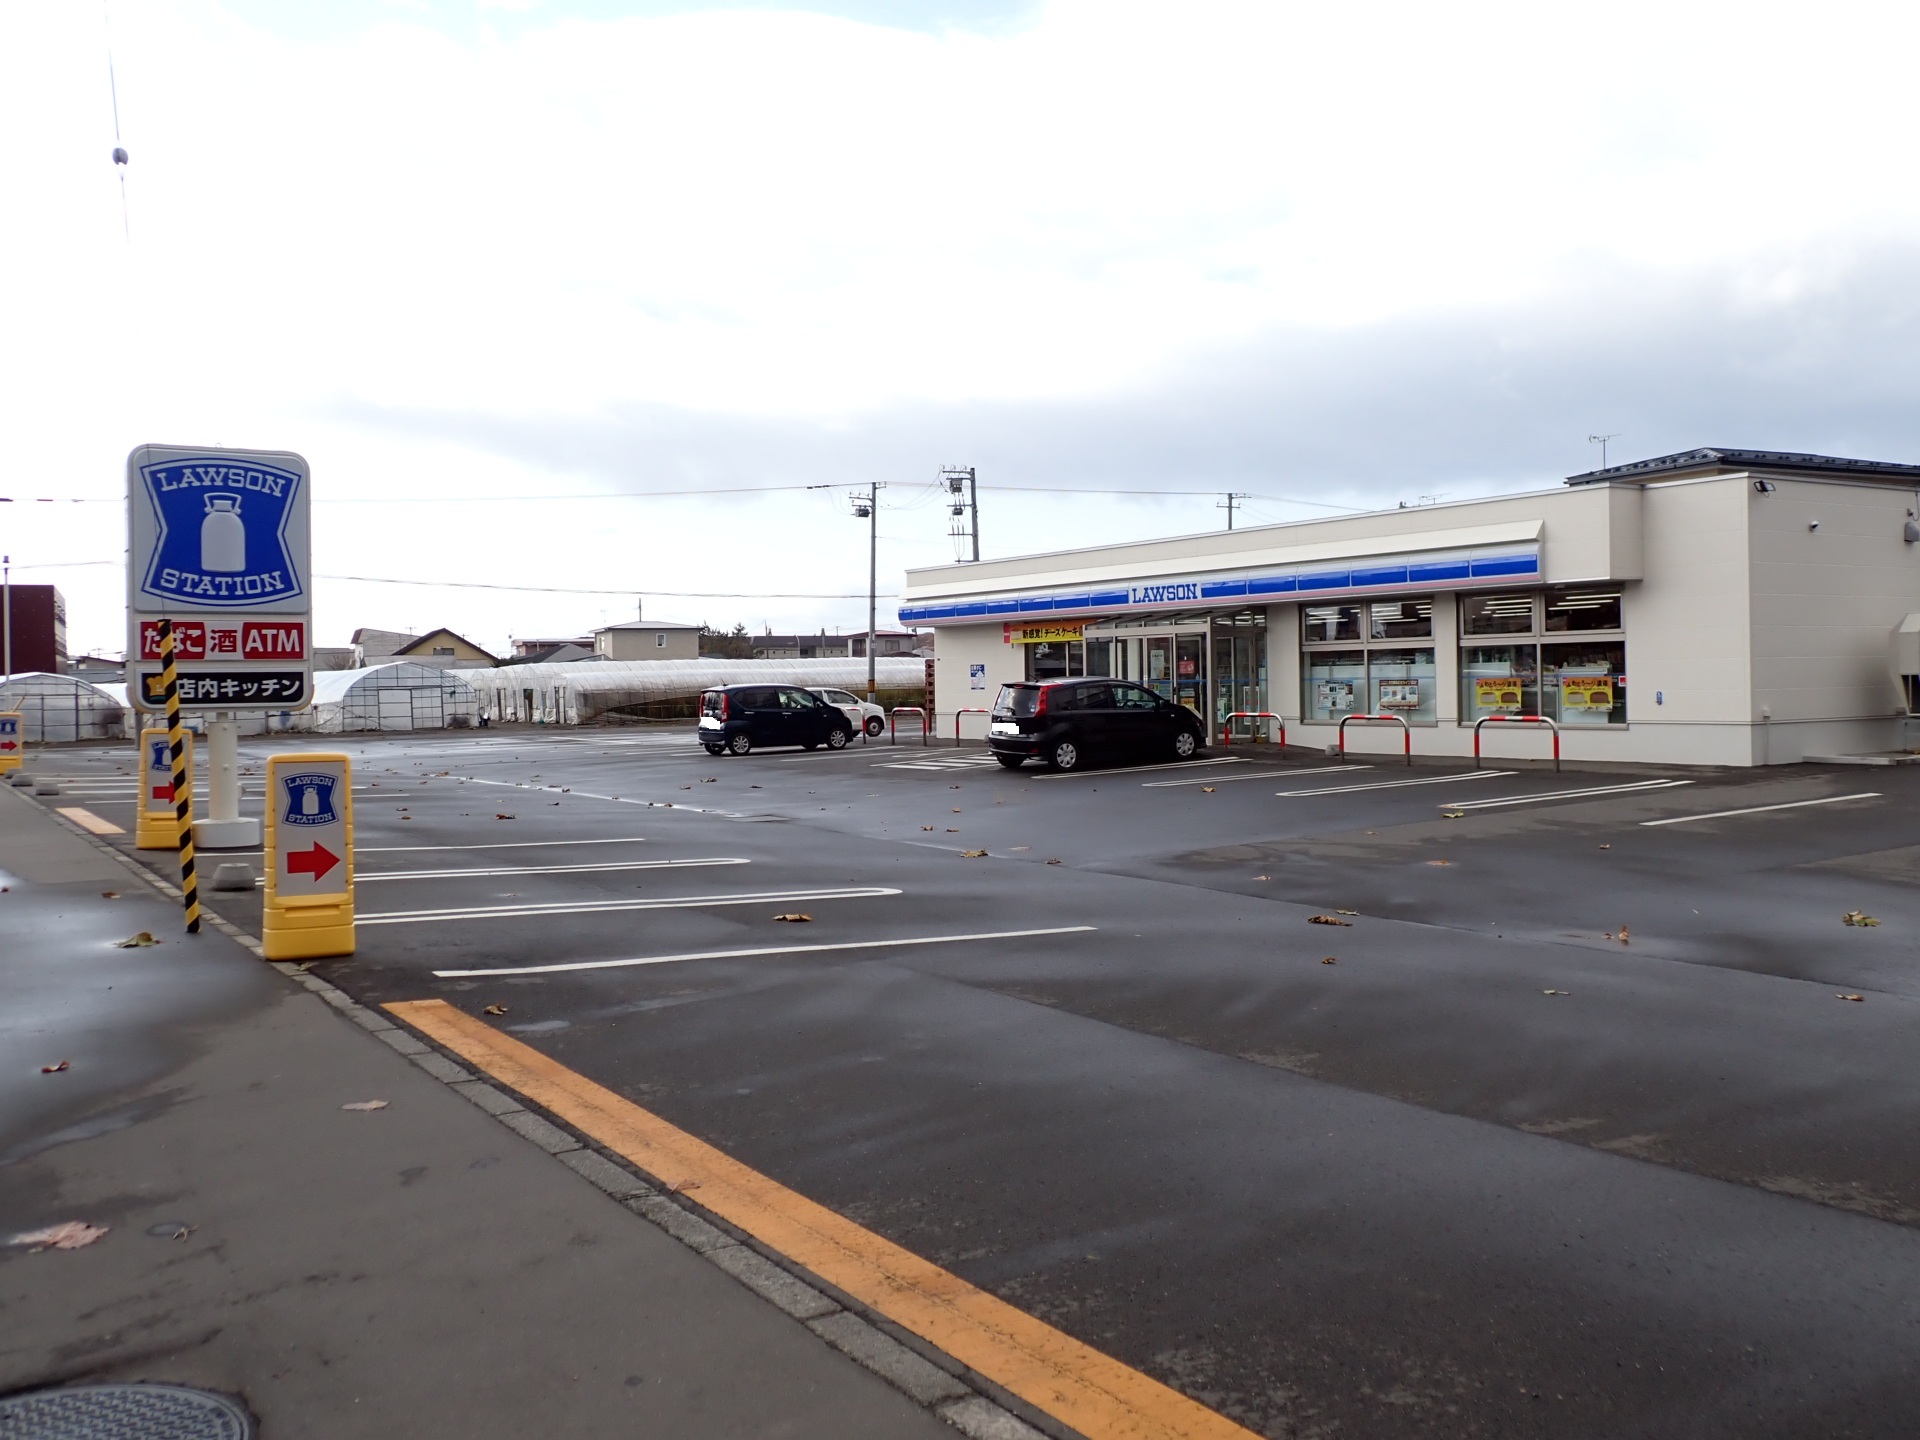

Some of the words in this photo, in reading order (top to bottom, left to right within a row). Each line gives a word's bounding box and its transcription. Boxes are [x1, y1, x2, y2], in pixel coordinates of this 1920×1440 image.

[157, 467, 286, 497] LAWSON
[160, 568, 285, 596] STATION
[1132, 583, 1198, 604] LAWSON
[210, 629, 237, 652] 酒
[245, 628, 300, 652] ATM
[176, 678, 300, 698] 店内キッチン
[287, 776, 333, 787] LAWSON
[288, 812, 333, 824] STATION
